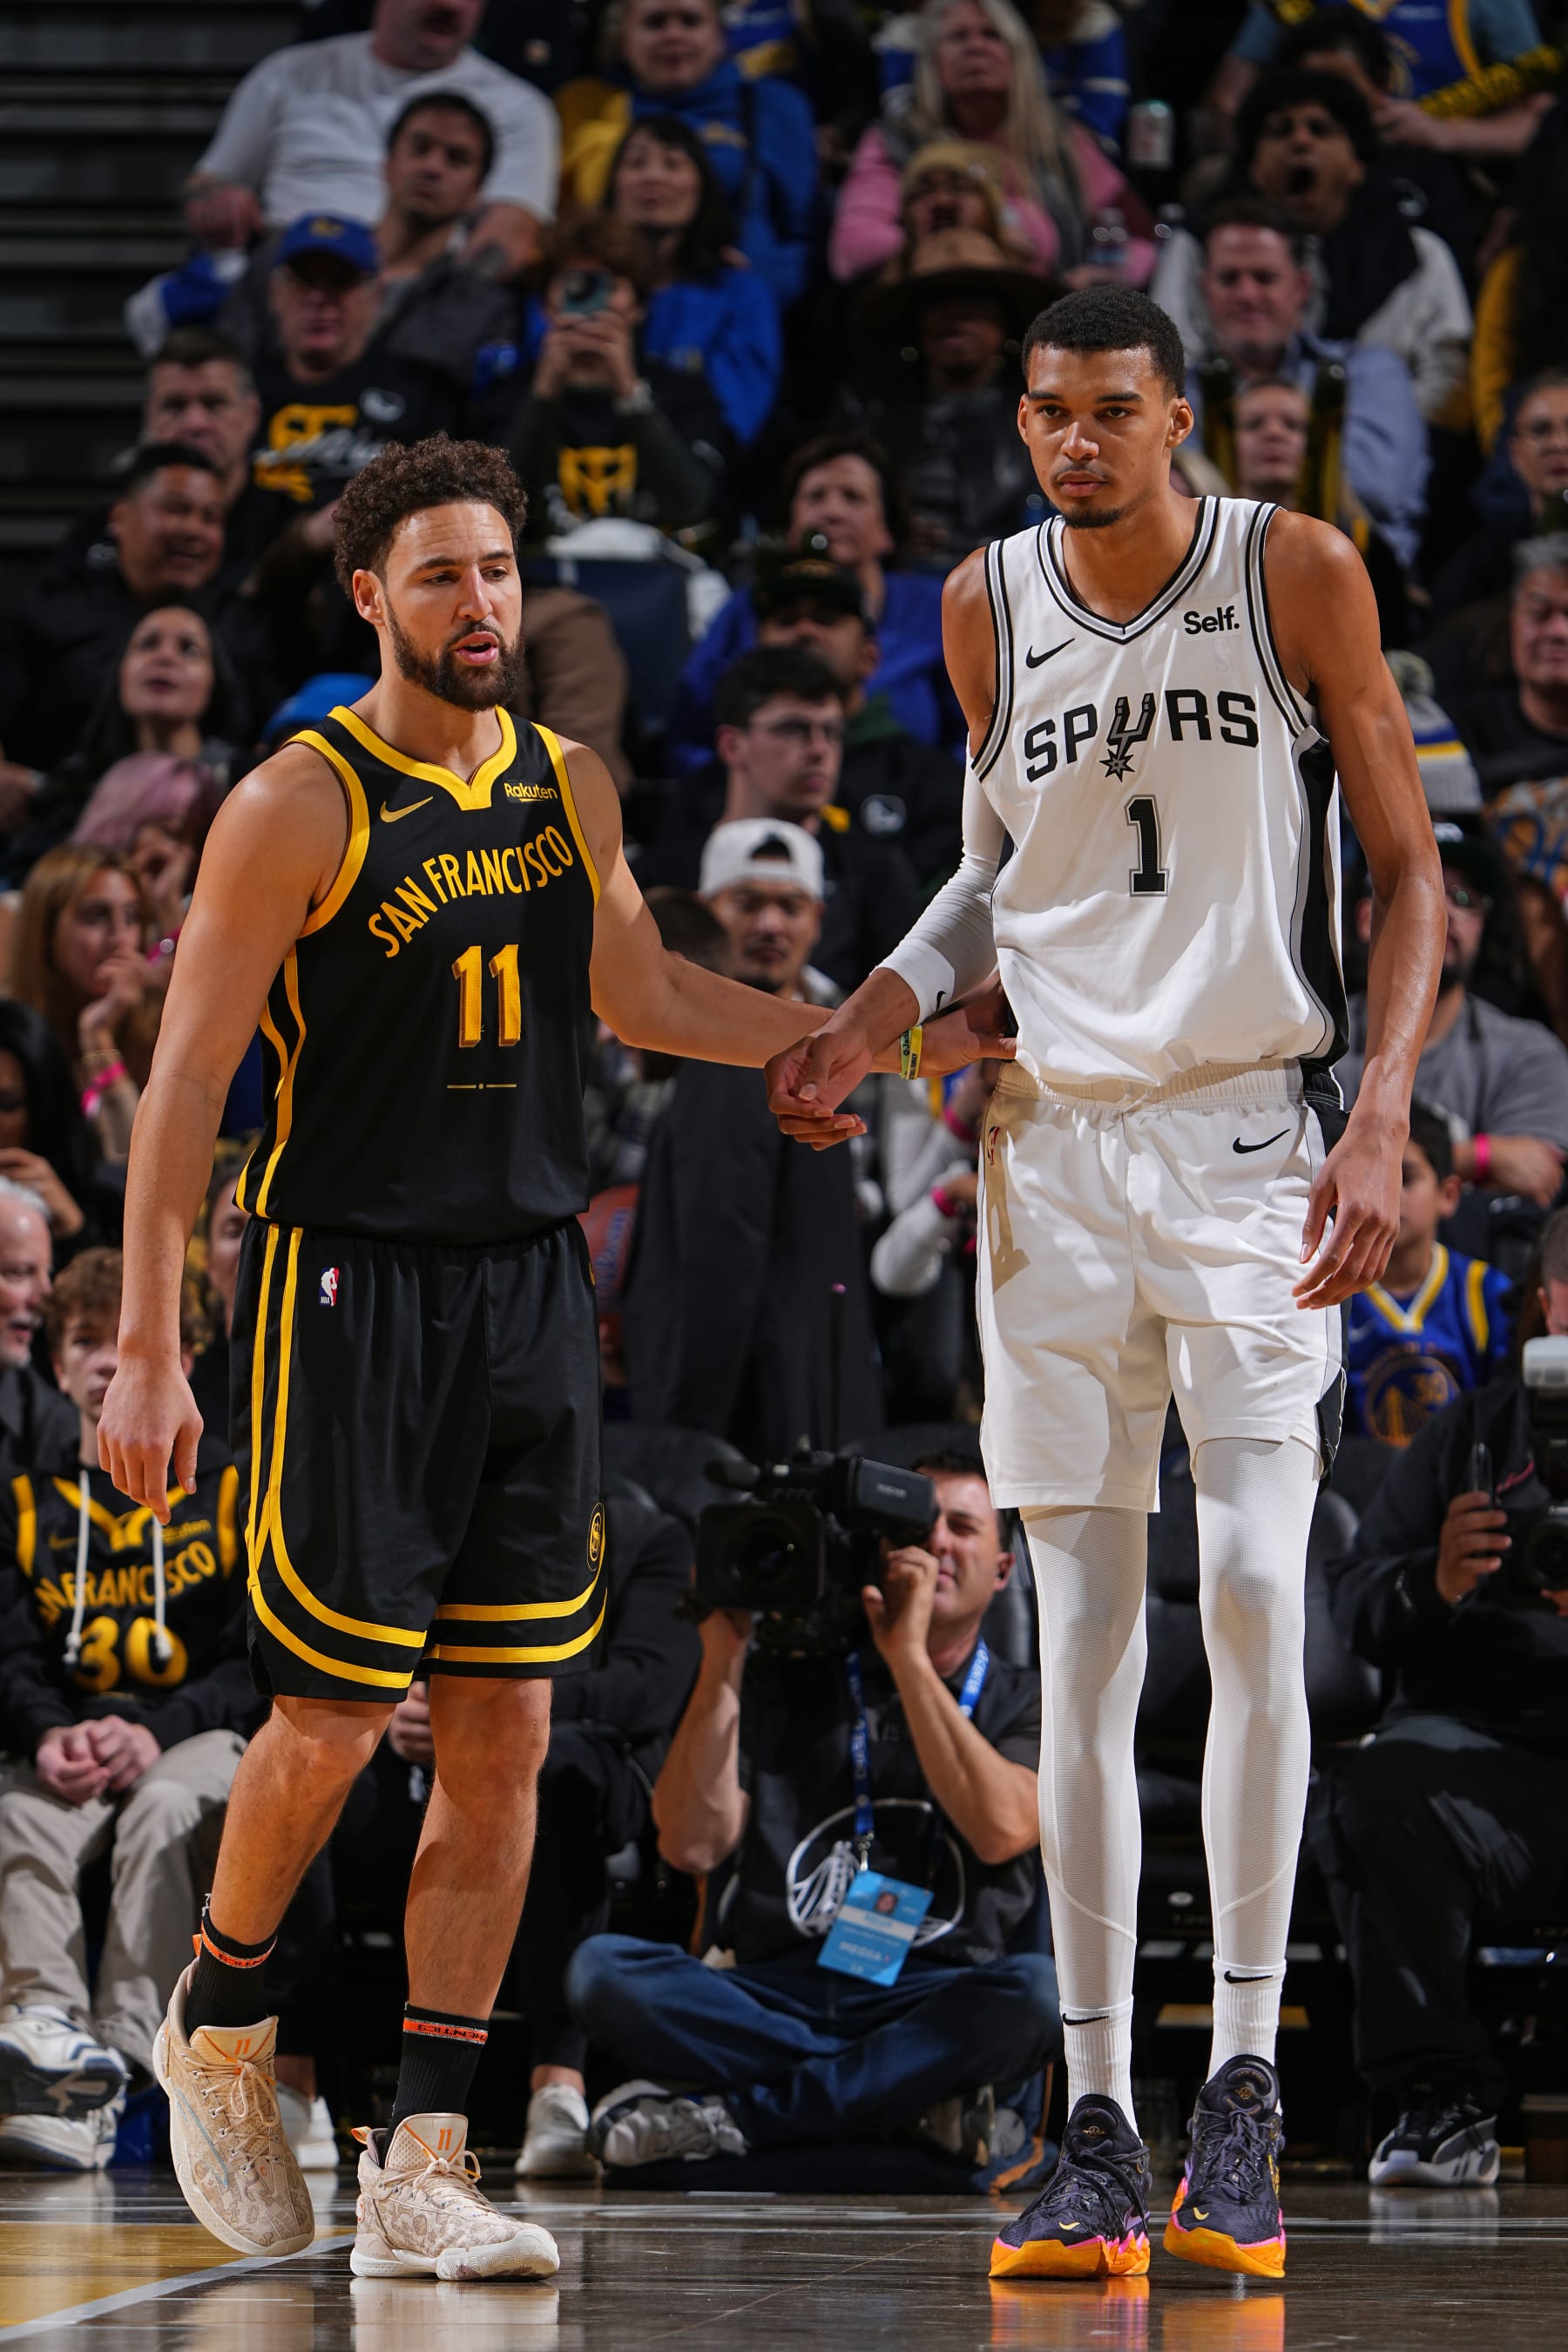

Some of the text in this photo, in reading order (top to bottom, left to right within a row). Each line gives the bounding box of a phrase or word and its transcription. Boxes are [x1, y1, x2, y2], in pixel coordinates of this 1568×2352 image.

[1183, 605, 1240, 635] Self.
[1024, 688, 1260, 782] SPURS
[504, 782, 558, 801] Rakuten
[1124, 794, 1170, 897] 1
[368, 825, 573, 958] SAN FRANCISCO
[451, 943, 522, 1047] 11
[60, 1540, 216, 1609] FRANCSCO
[74, 1615, 188, 1692] 30
[233, 2038, 252, 2056] 11
[437, 2128, 453, 2151] 11
